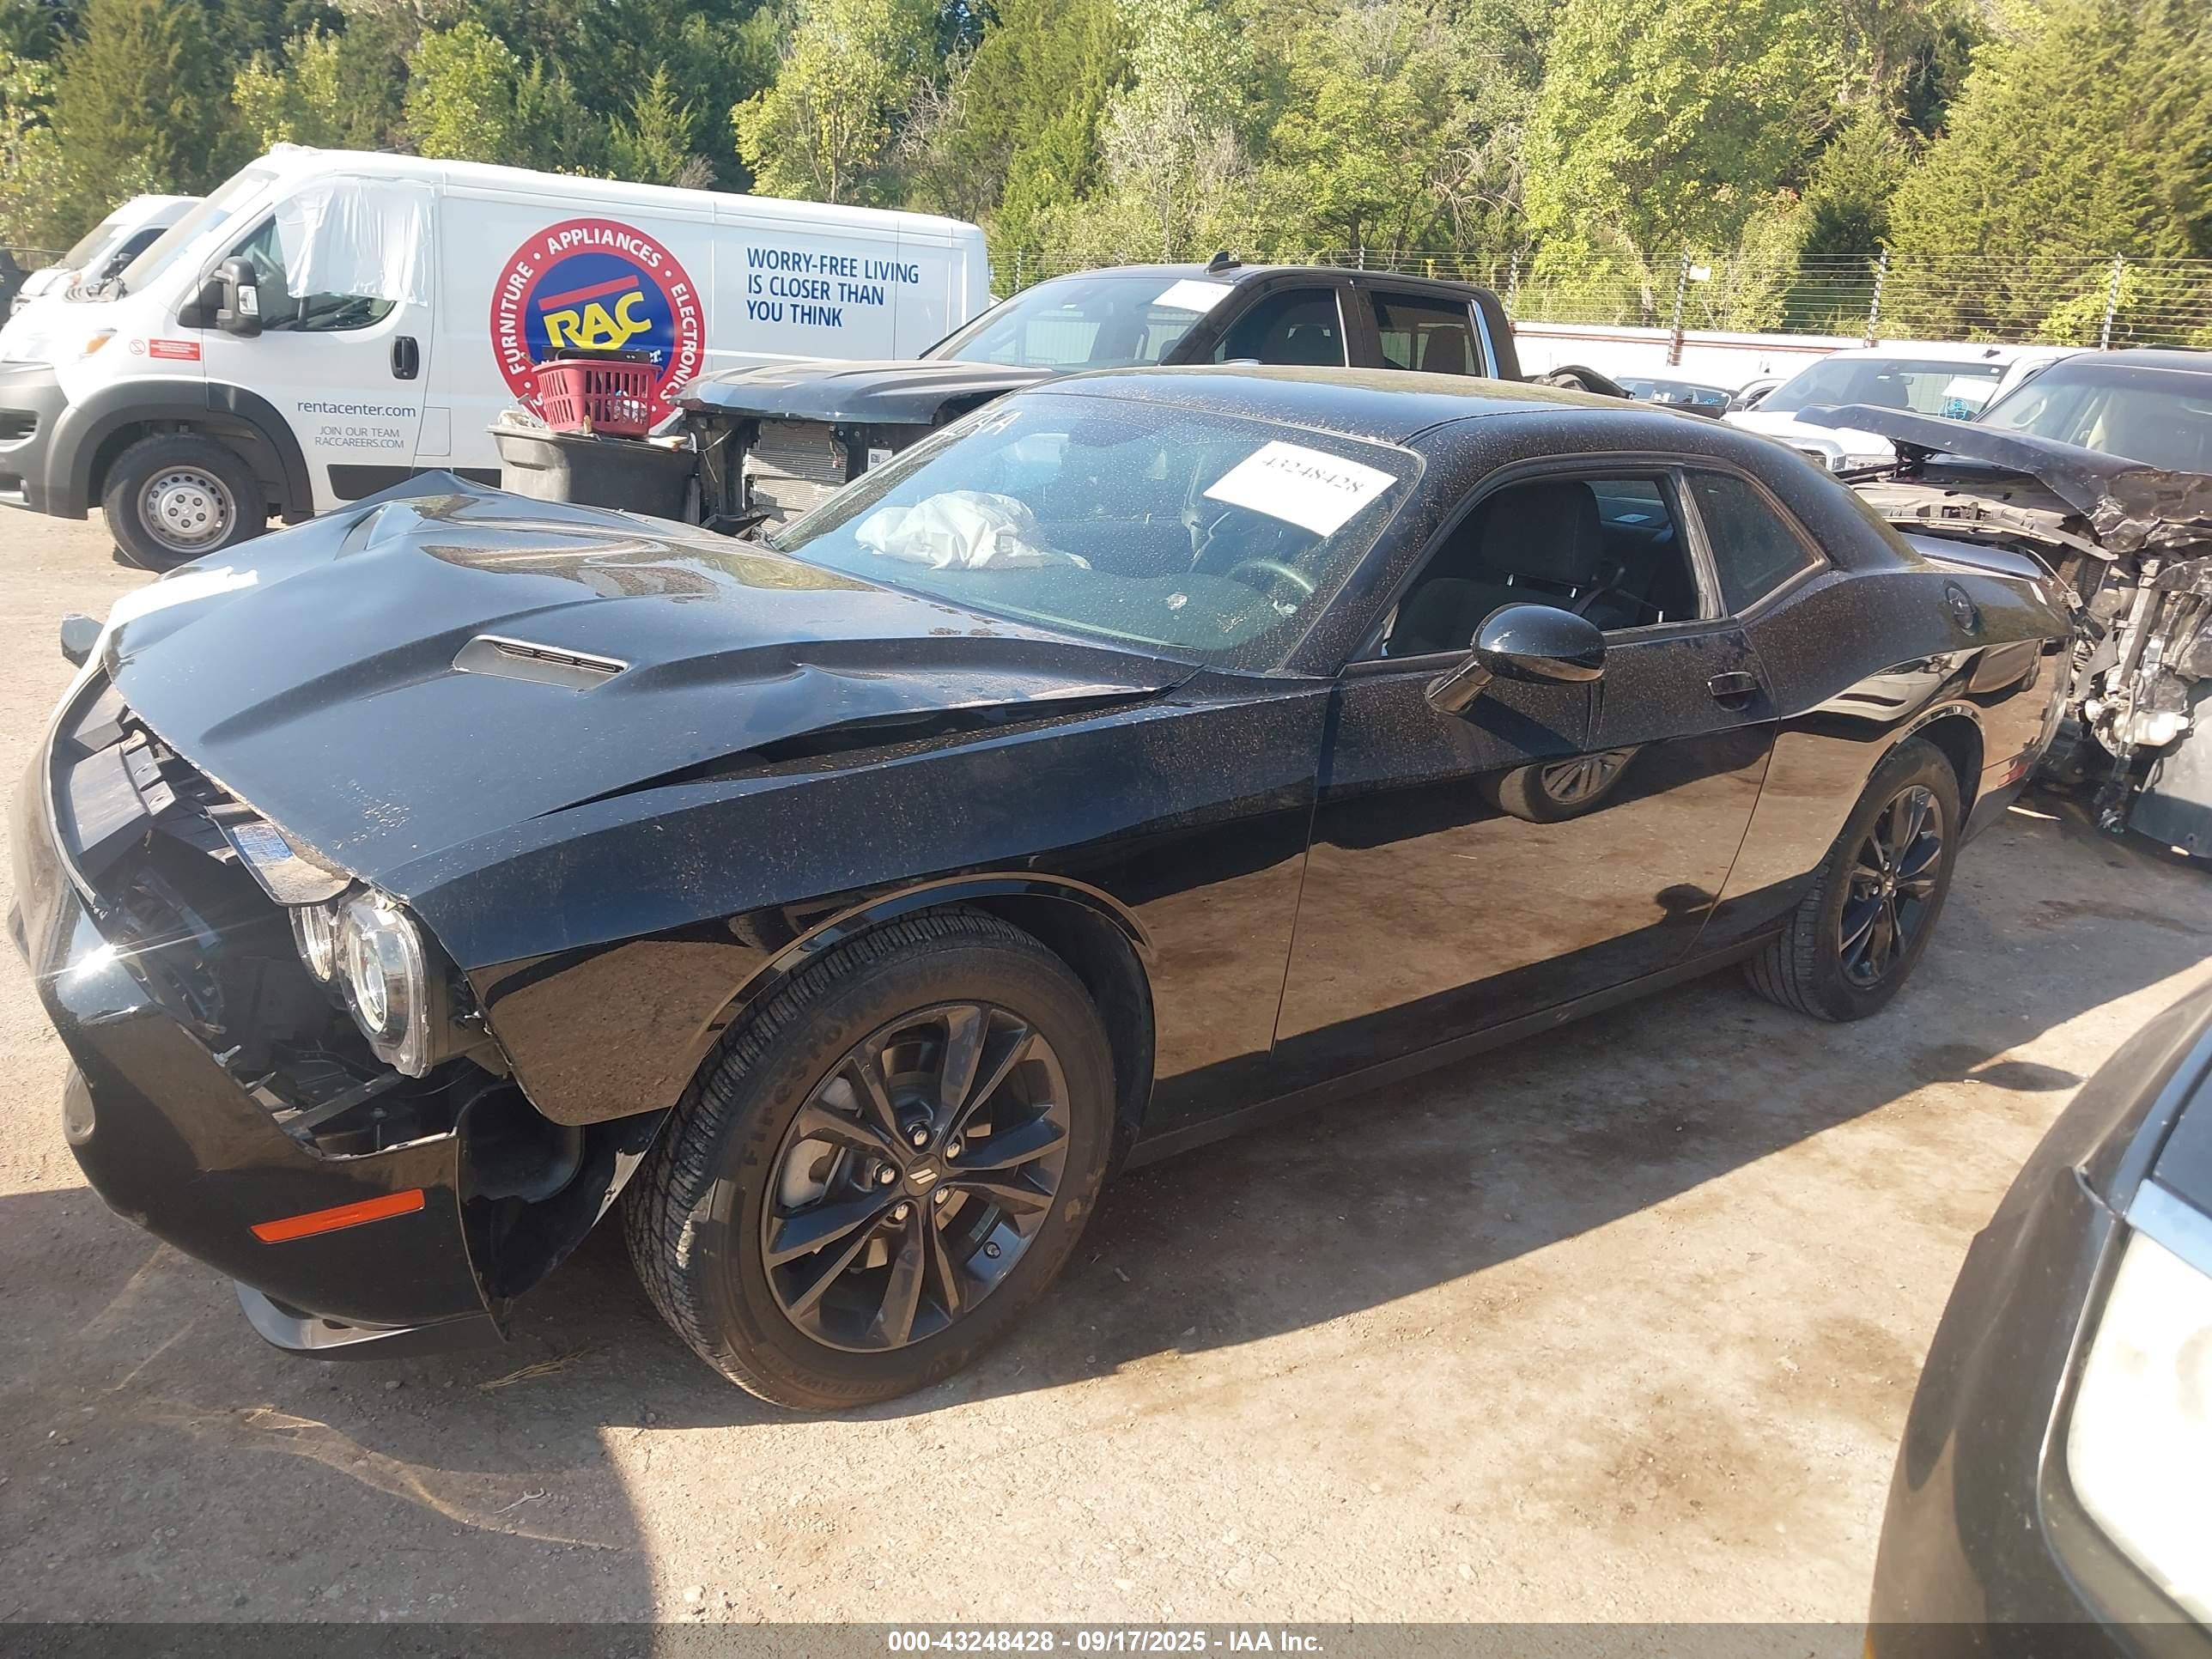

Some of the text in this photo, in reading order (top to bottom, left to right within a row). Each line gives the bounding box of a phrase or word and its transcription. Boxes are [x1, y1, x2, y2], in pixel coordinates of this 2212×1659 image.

[546, 228, 662, 268] APPLIANCES
[746, 247, 920, 283] WORRY-FREE LIVING
[748, 274, 884, 306] IS CLOSER THAN
[499, 261, 534, 375] FURNITURE
[543, 291, 652, 350] RAC
[746, 300, 843, 327] YOU THINK
[297, 401, 416, 417] rentacenter.com
[315, 437, 404, 448] RACCAREERS.COM
[319, 426, 399, 438] JOIN OUR TEAM
[1262, 457, 1364, 493] 43248428
